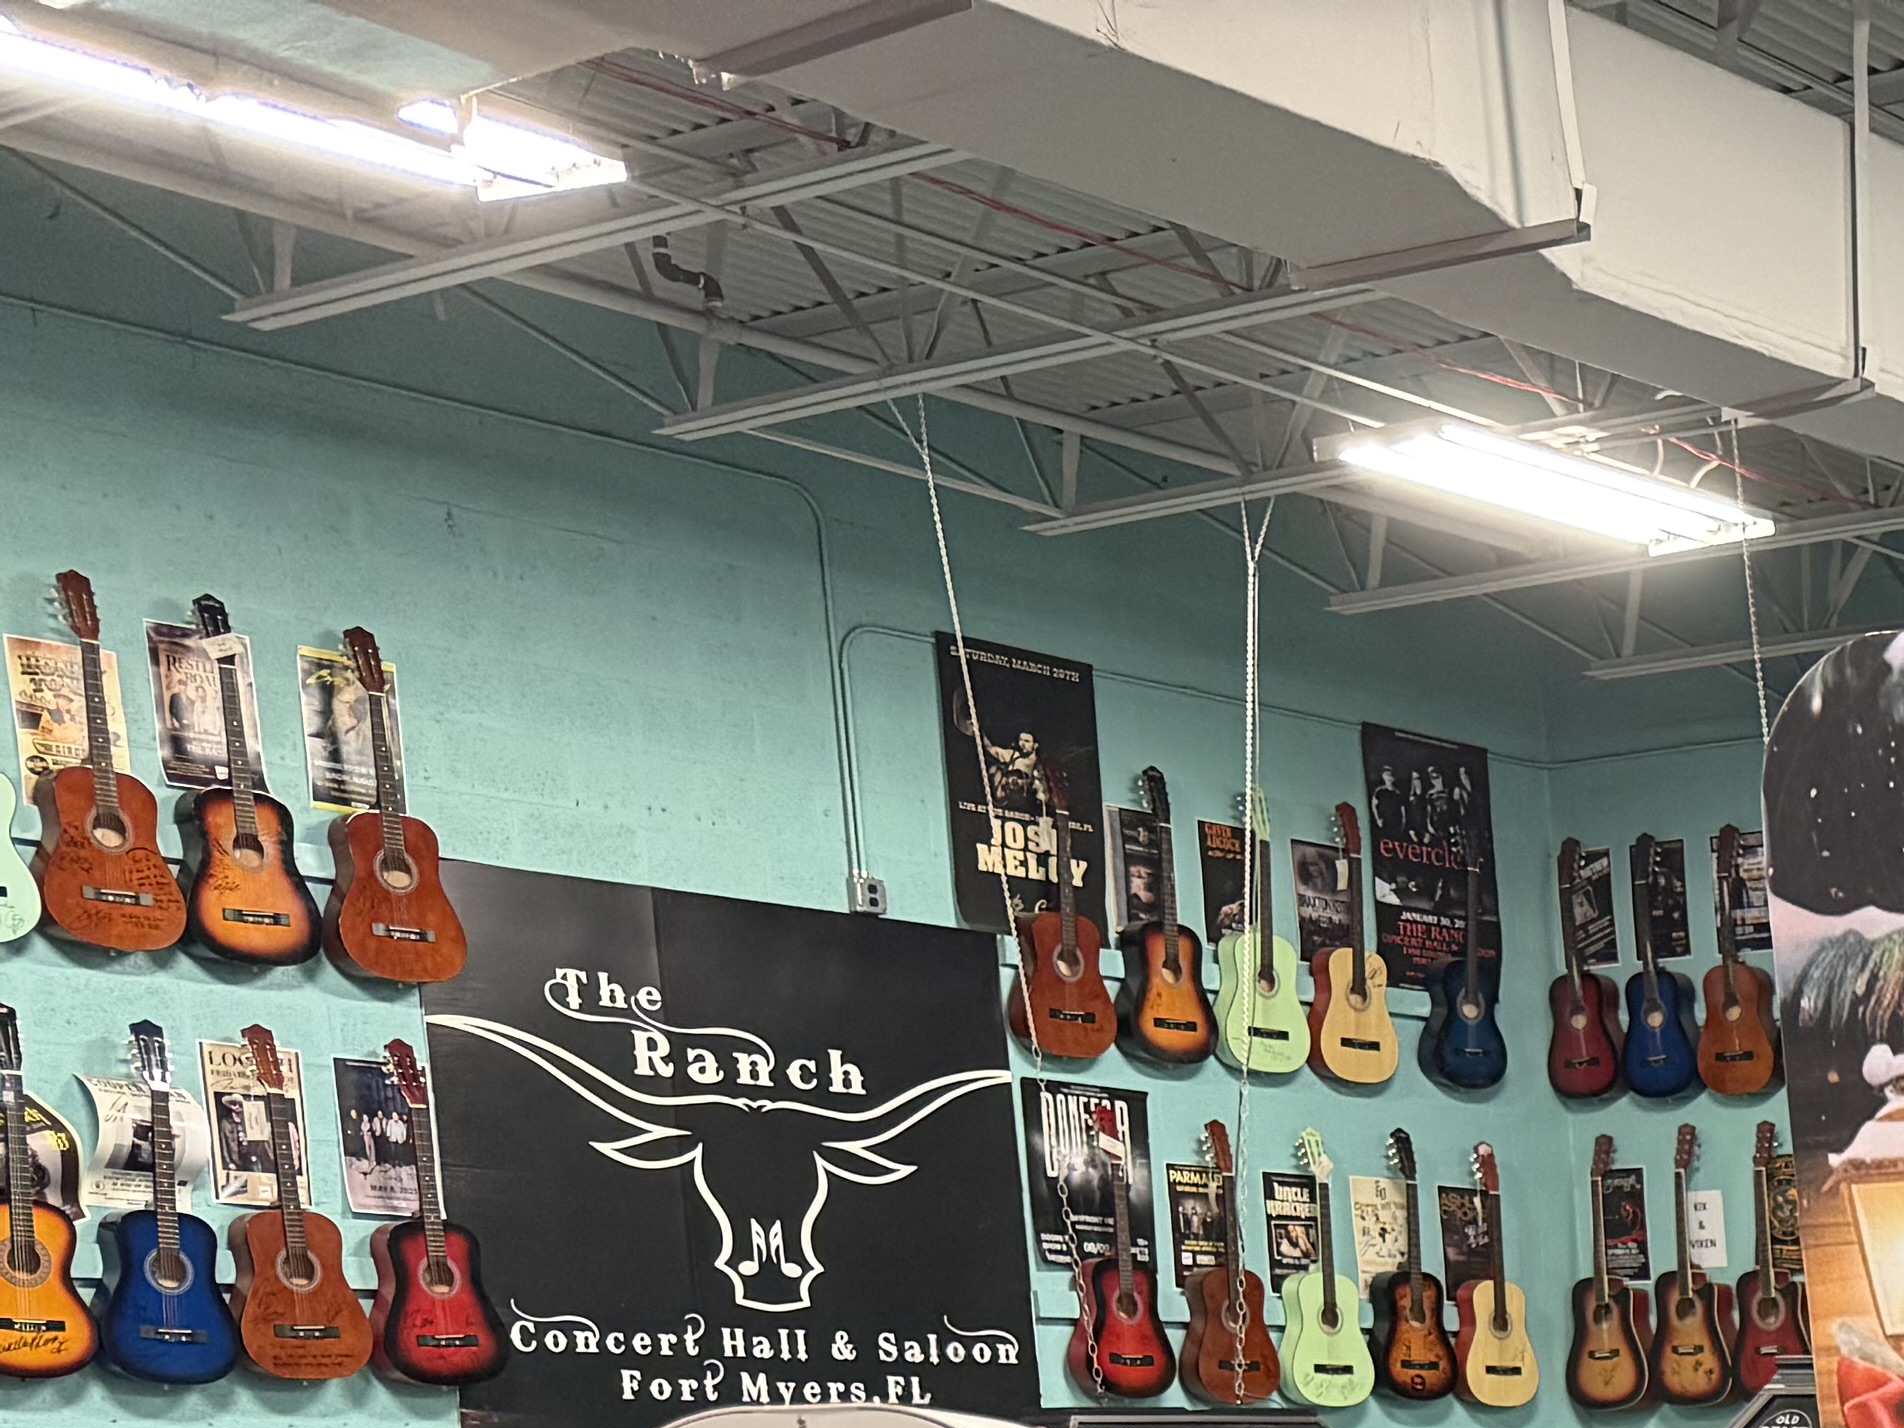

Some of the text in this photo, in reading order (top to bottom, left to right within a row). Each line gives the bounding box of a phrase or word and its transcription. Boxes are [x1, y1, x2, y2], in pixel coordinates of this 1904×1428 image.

[1011, 658, 1050, 676] MARCH
[1379, 838, 1485, 874] everclr
[1397, 920, 1466, 943] THE RANC
[544, 967, 663, 1011] The
[630, 1028, 868, 1096] Ranch
[509, 1298, 1020, 1366] Concert Hall & Saloon
[620, 1358, 725, 1402] Fort
[1775, 1414, 1800, 1425] OLD
